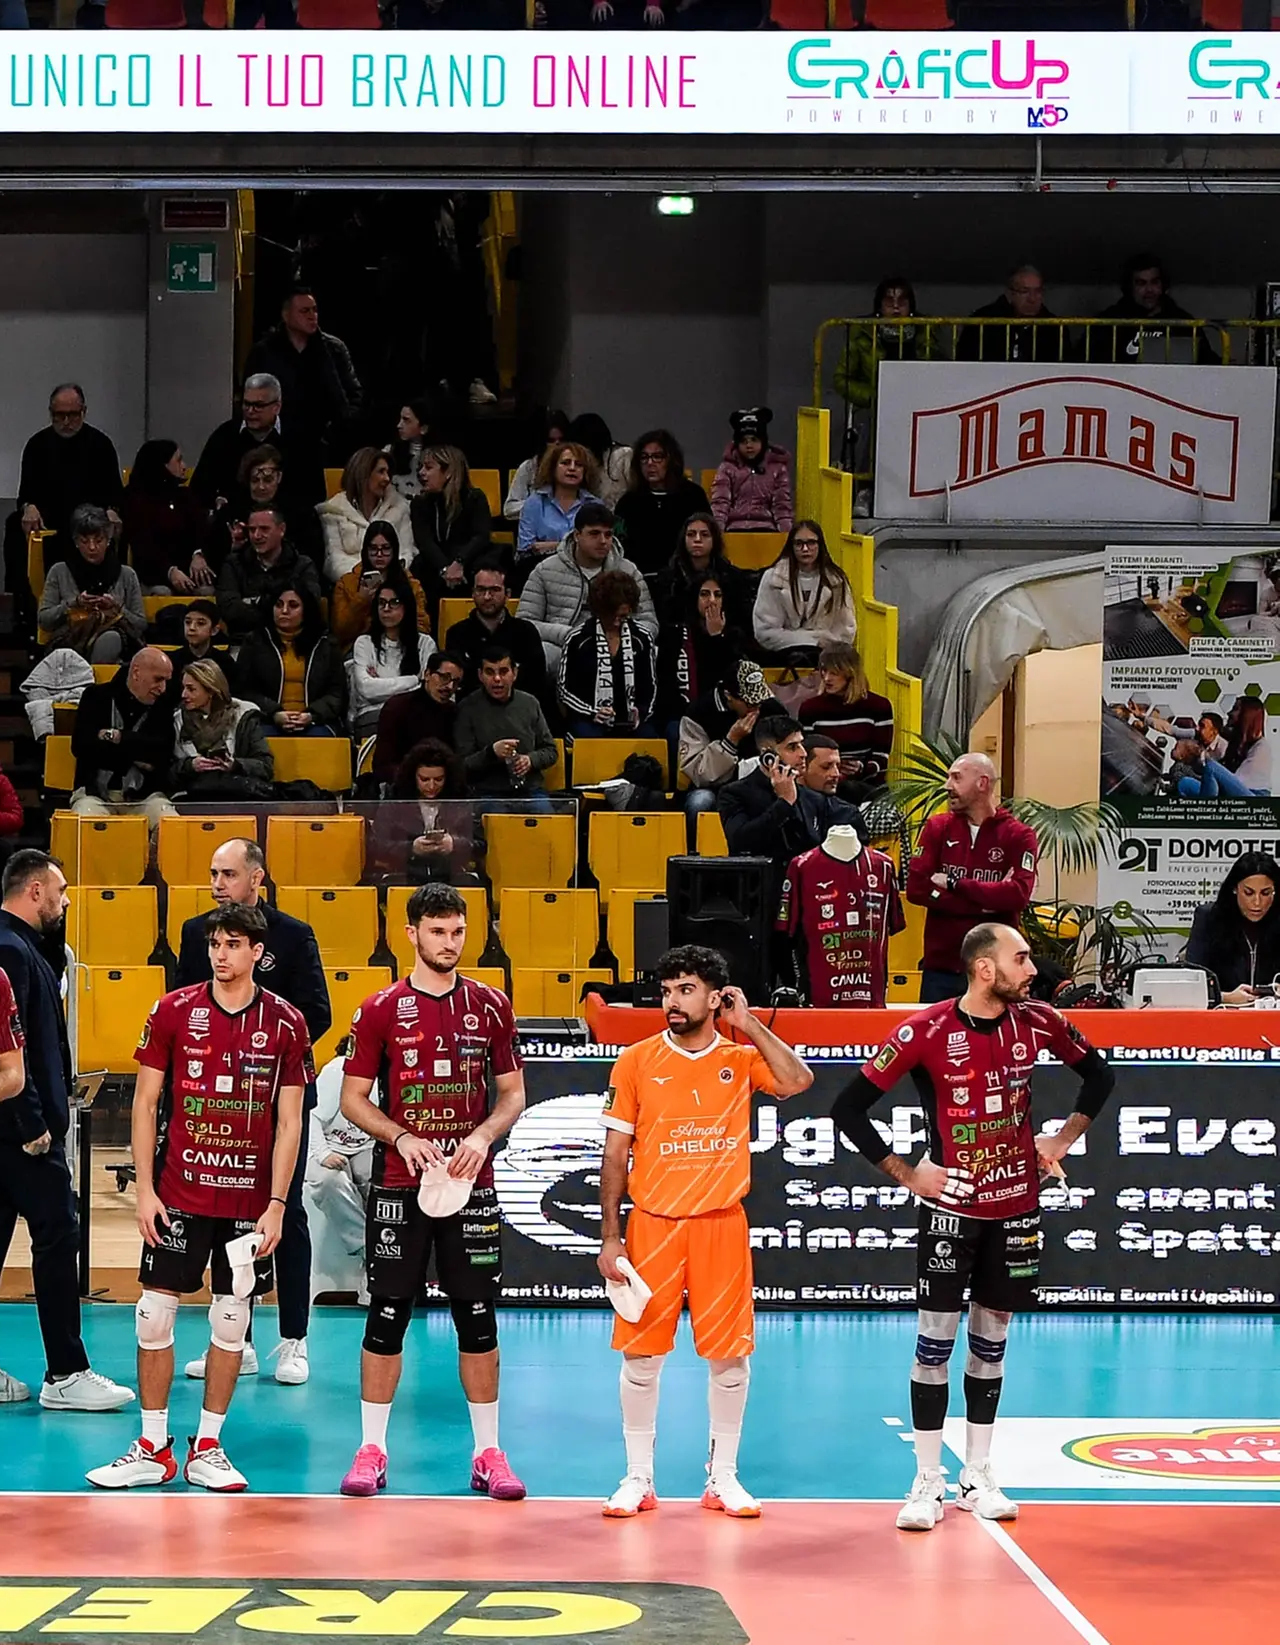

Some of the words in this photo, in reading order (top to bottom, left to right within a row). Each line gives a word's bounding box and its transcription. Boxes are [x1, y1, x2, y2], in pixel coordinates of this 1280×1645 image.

[11, 54, 151, 107] UNICO
[179, 54, 212, 107] IL
[237, 54, 323, 107] TUO
[352, 54, 506, 107] BRAND
[533, 55, 696, 108] ONLINE
[787, 109, 933, 123] POWERED
[967, 109, 998, 123] BY
[955, 402, 1198, 487] Mamas
[1111, 556, 1142, 564] SISTEMI
[1144, 556, 1183, 564] RADIANTI
[1191, 638, 1216, 646] STUFE
[1227, 638, 1274, 647] CAMINETTI
[1111, 666, 1163, 675] IMPIANTO
[1165, 667, 1240, 676] FOTOVOLTAICO
[435, 1036, 448, 1051] 2
[222, 1052, 232, 1068] 4
[1113, 1046, 1179, 1061] Eventi
[985, 1071, 1000, 1087] 14
[691, 1088, 701, 1106] 1
[207, 1099, 265, 1112] DOMOTEK
[403, 1108, 455, 1120] GOLD
[185, 1120, 232, 1135] GOLD
[669, 1121, 726, 1138] Amaro
[659, 1137, 738, 1156] DHELIOS
[182, 1149, 257, 1169] CANALE
[199, 1173, 216, 1183] CTL
[217, 1174, 256, 1185] ECOLOGY
[995, 1182, 1029, 1197] ECOLOGY
[161, 1235, 188, 1250] OASI
[375, 1243, 401, 1256] OASI
[145, 1253, 154, 1271] 4
[928, 1257, 957, 1270] OASI
[919, 1277, 930, 1296] 14
